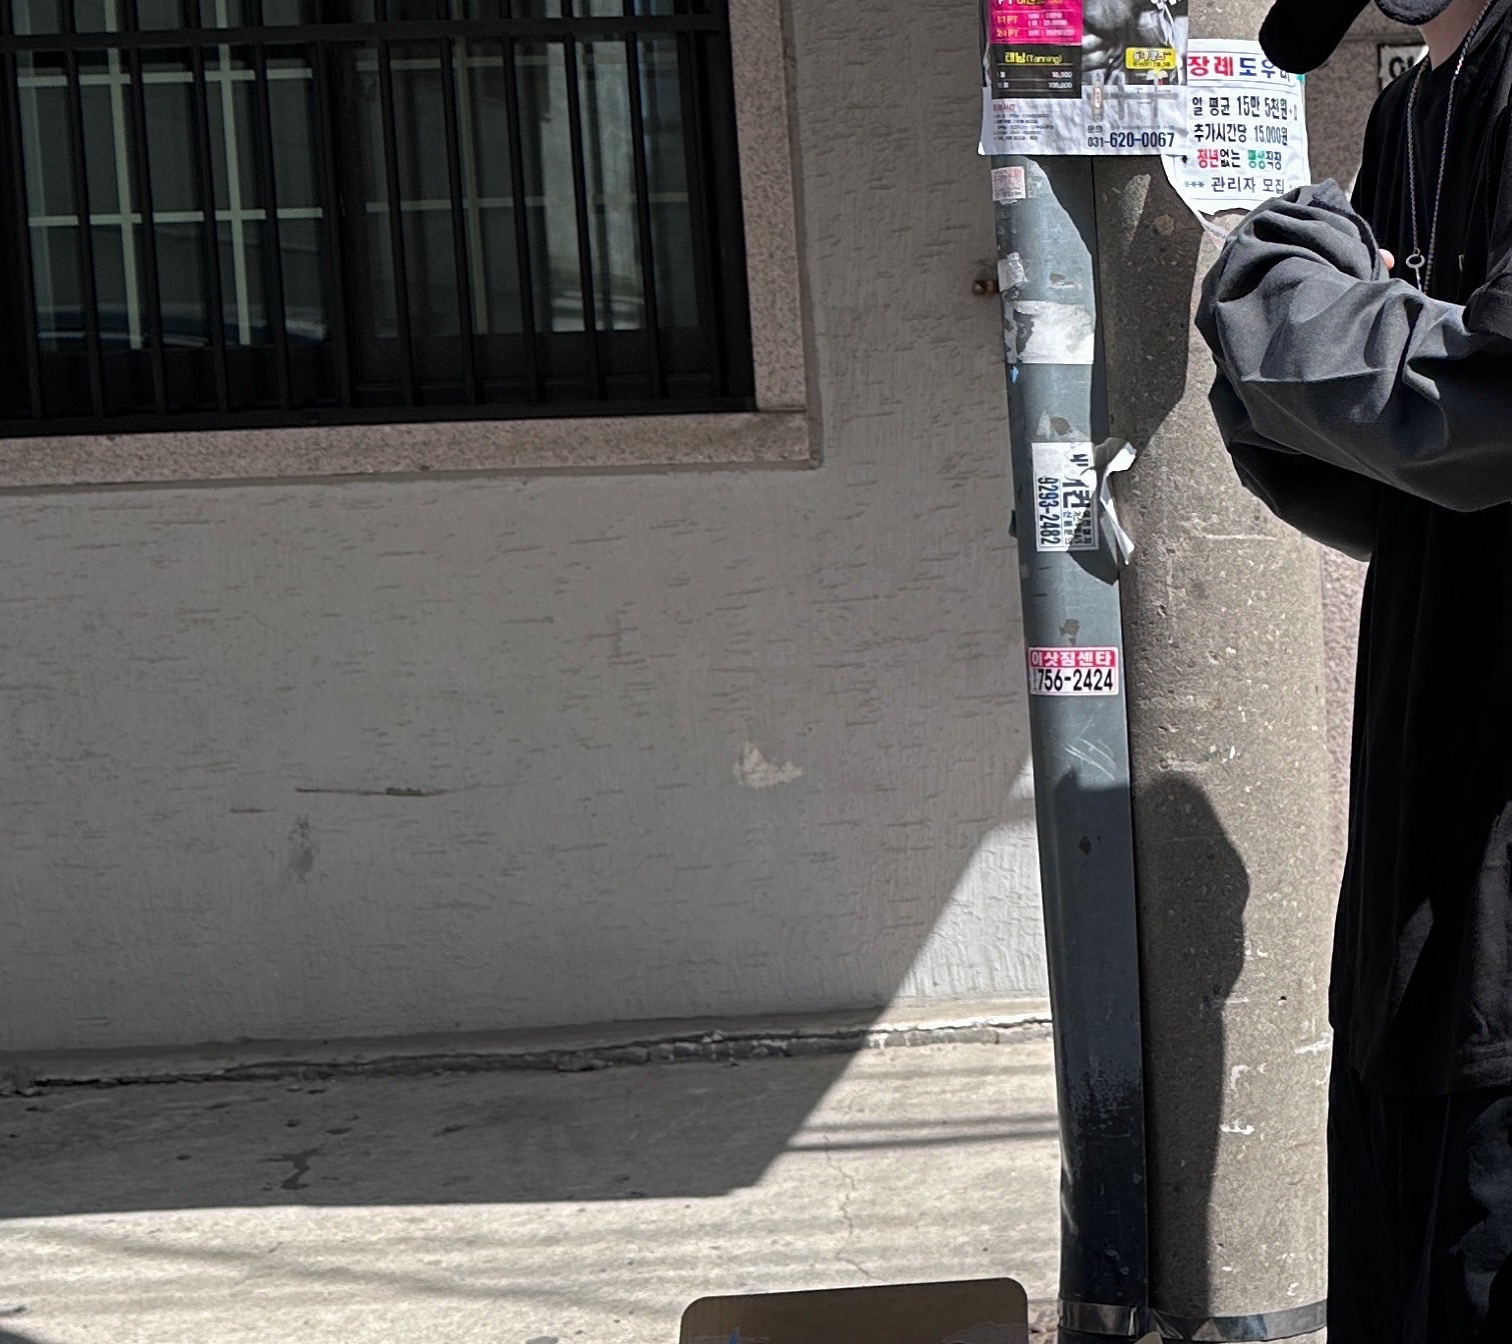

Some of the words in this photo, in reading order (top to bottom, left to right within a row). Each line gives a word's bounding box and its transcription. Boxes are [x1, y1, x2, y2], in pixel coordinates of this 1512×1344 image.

[1187, 55, 1234, 77] 장례
[1192, 96, 1204, 116] 일
[1209, 96, 1231, 117] 평균
[1237, 96, 1261, 118] 15만
[1088, 132, 1175, 148] 031-620-0067
[1194, 123, 1247, 143] 추가시간당
[1211, 176, 1256, 193] 관리자
[1262, 178, 1285, 194] 모집
[1031, 651, 1112, 667] 이삿짐센타
[1038, 668, 1113, 691] 756-2424
